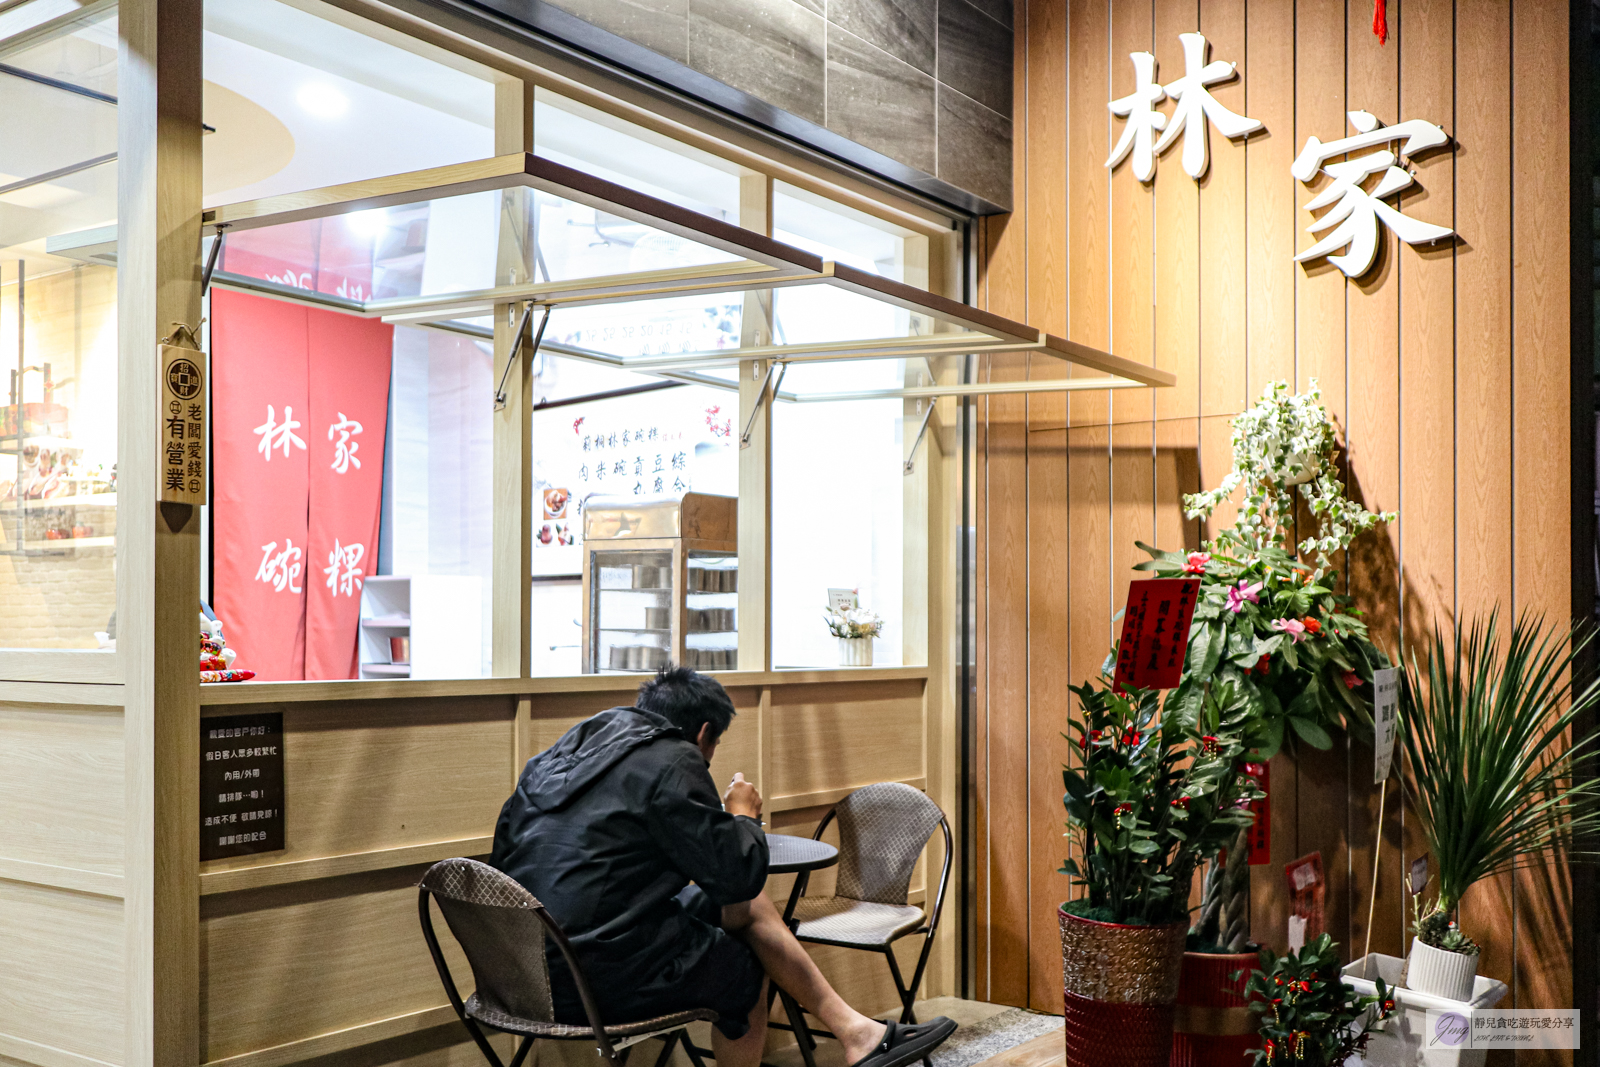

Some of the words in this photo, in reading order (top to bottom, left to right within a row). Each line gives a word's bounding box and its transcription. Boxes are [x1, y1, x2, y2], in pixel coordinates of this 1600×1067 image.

[1105, 32, 1454, 278] 林家
[166, 415, 186, 492] 有營業
[187, 403, 202, 478] 老闆愛錢
[253, 404, 364, 475] 林家
[255, 538, 365, 598] 碗粿
